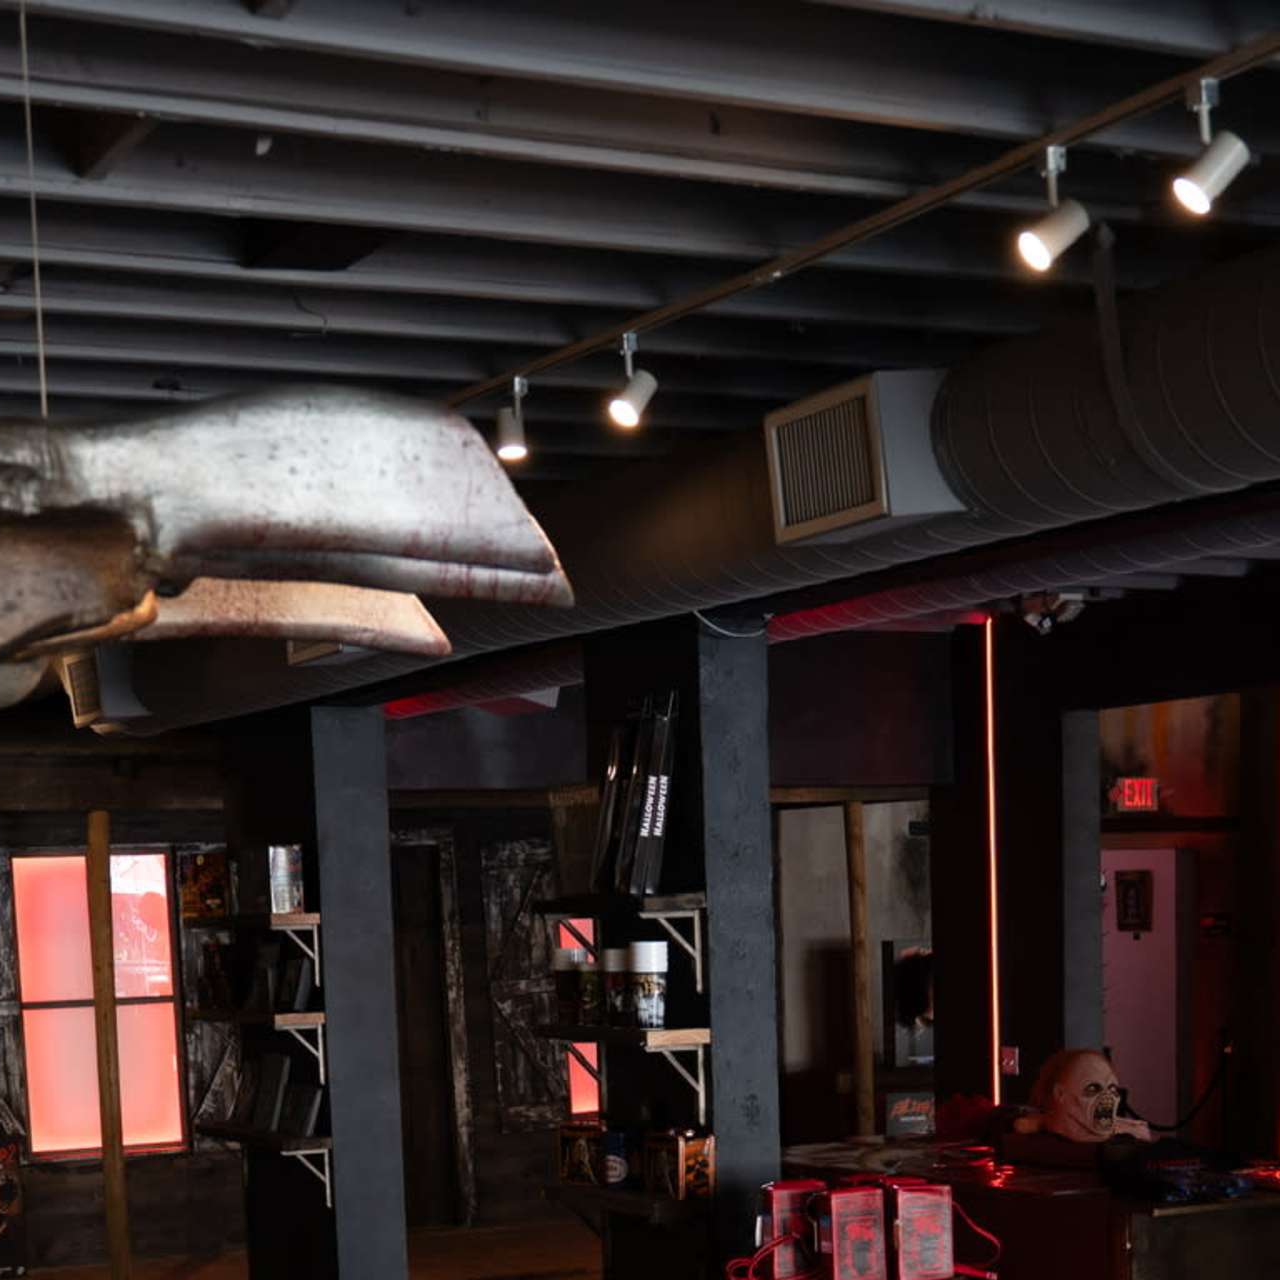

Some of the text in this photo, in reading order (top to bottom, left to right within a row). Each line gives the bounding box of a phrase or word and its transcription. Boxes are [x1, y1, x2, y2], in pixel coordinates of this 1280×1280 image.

[640, 775, 657, 837] HALLOWEEN
[653, 775, 669, 837] HALLOWEEN
[1123, 779, 1153, 808] EXIT
